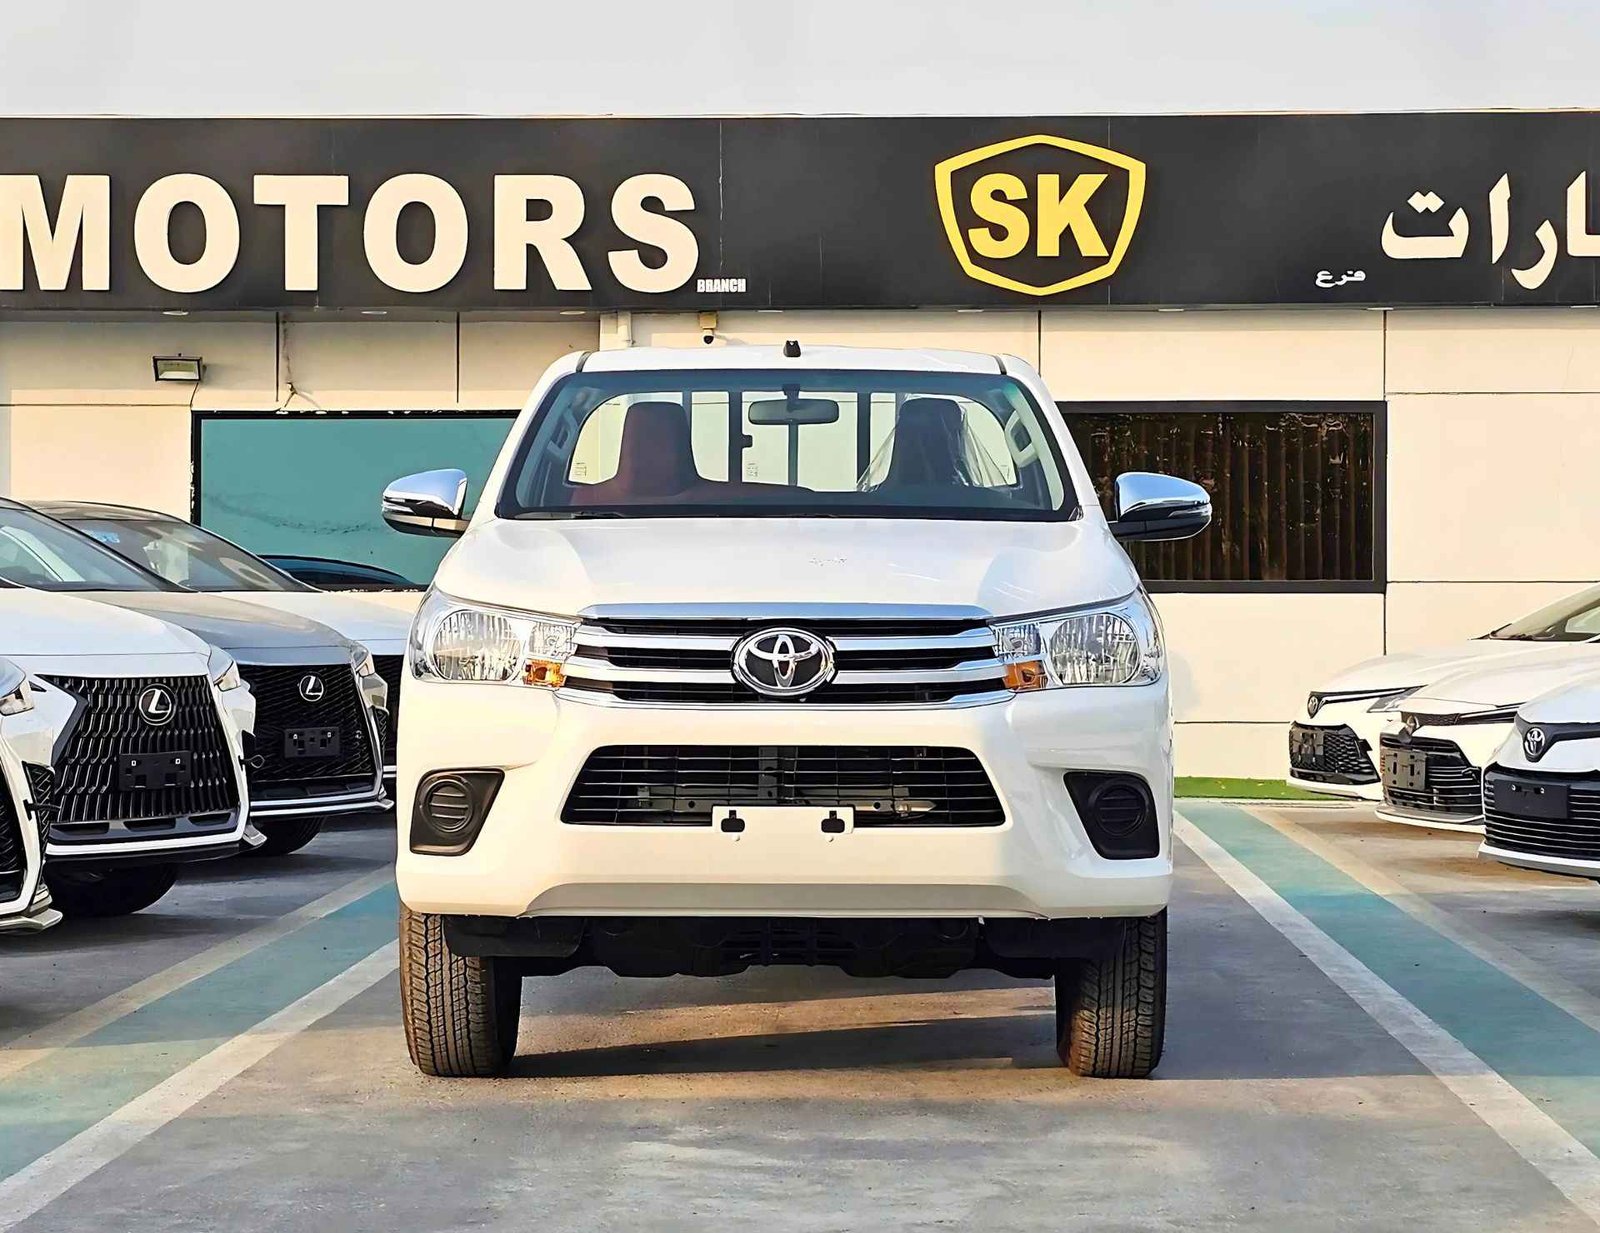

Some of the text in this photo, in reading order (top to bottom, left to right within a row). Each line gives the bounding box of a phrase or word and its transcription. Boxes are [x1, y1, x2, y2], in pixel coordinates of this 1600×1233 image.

[0, 173, 698, 293] MOTORS
[967, 172, 1111, 259] SK
[1381, 170, 1600, 290] ارات
[696, 278, 747, 293] BRANCH
